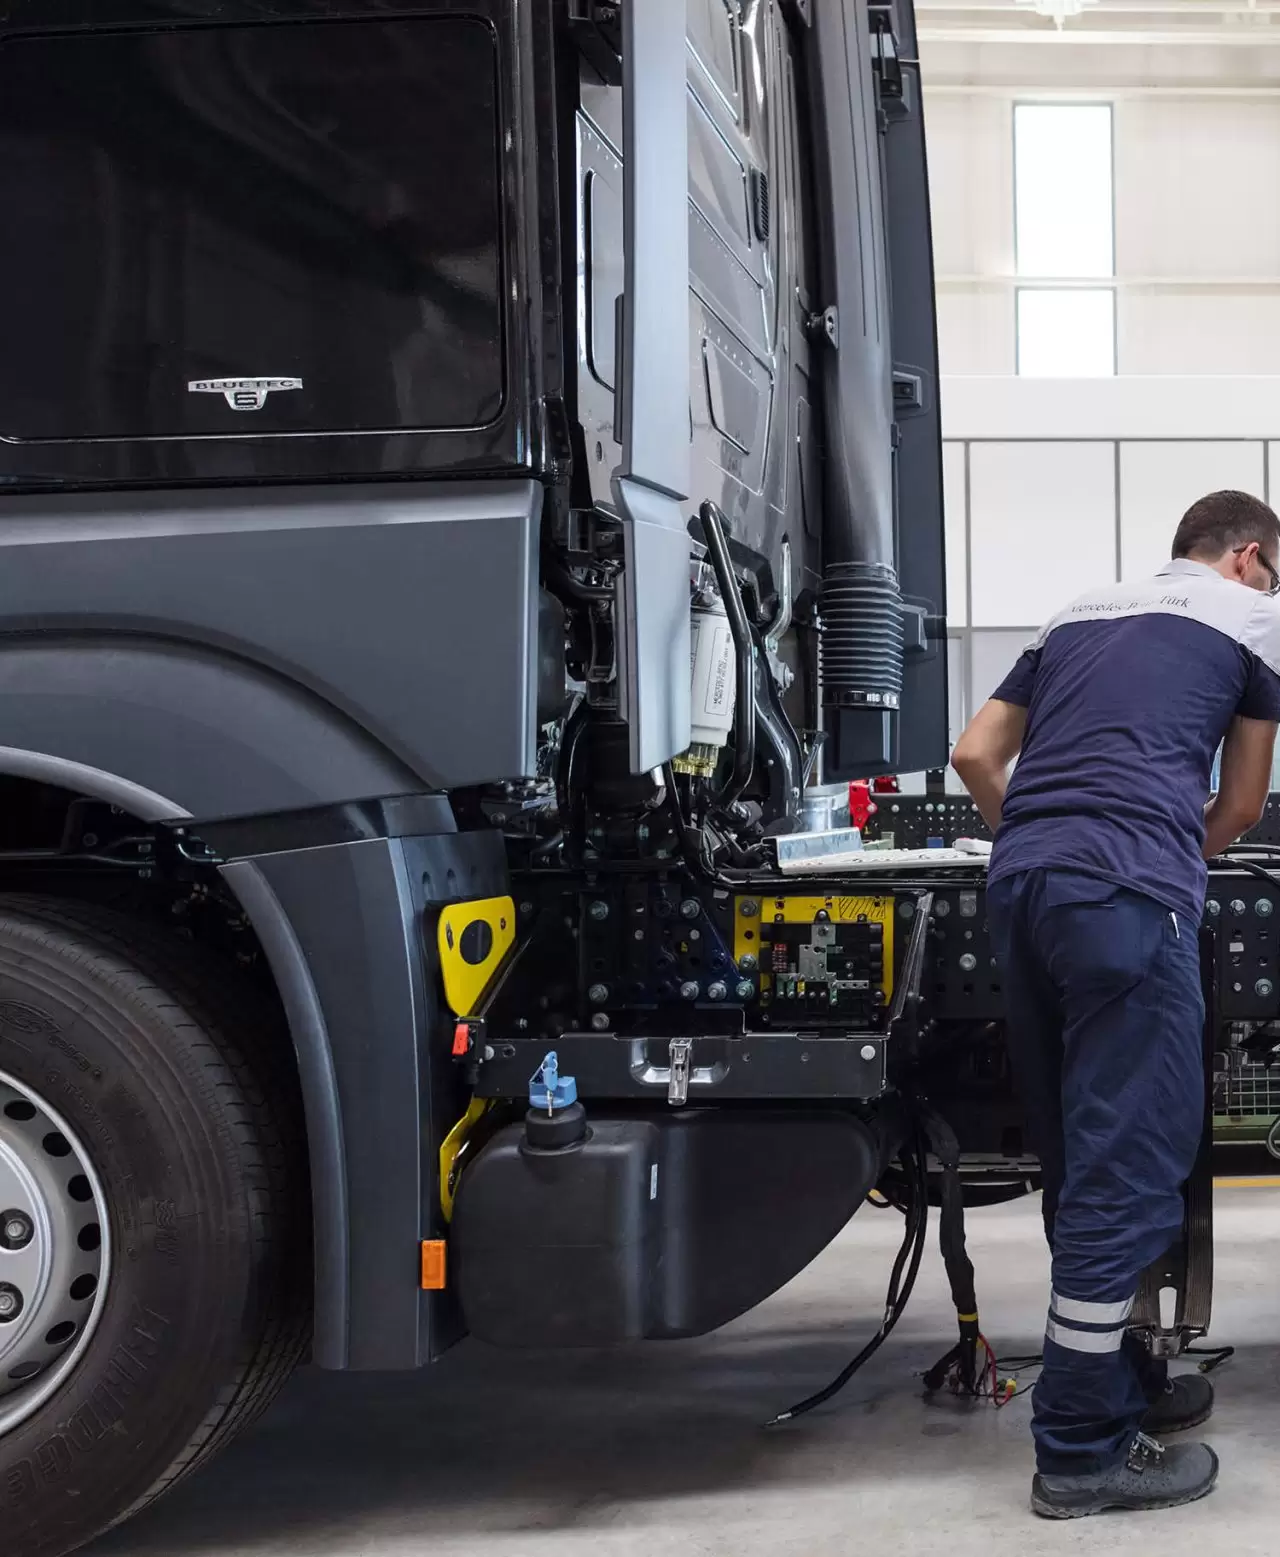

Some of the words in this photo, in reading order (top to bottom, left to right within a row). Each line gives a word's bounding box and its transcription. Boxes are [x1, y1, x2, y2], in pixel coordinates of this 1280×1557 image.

[195, 380, 293, 390] BLUETEC
[233, 391, 259, 406] 6
[1160, 595, 1189, 608] Türk
